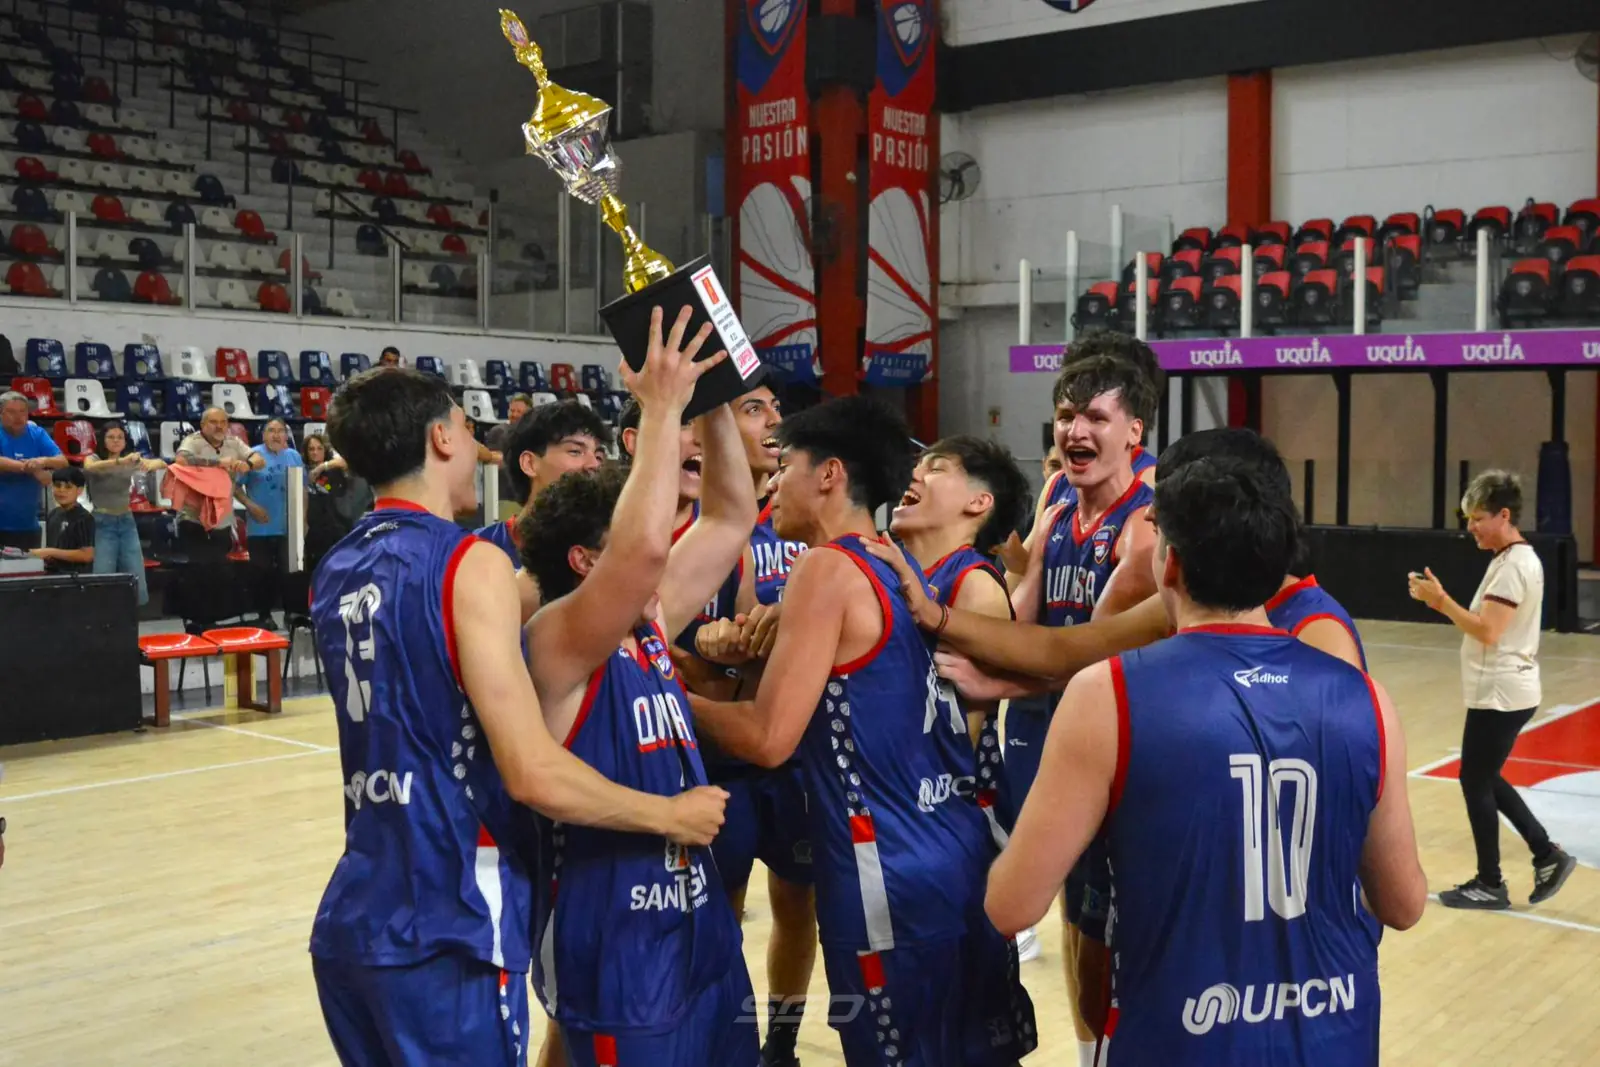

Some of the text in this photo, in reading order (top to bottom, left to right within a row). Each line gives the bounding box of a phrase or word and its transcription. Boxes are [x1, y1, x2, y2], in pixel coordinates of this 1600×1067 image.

[749, 97, 796, 128] NUESTRA
[742, 124, 807, 165] PASIÓN
[1034, 354, 1064, 370] UQU
[77, 384, 87, 392] 170
[1250, 672, 1289, 684] Adhoc
[1229, 753, 1318, 922] 10
[1242, 973, 1356, 1024] UPCN
